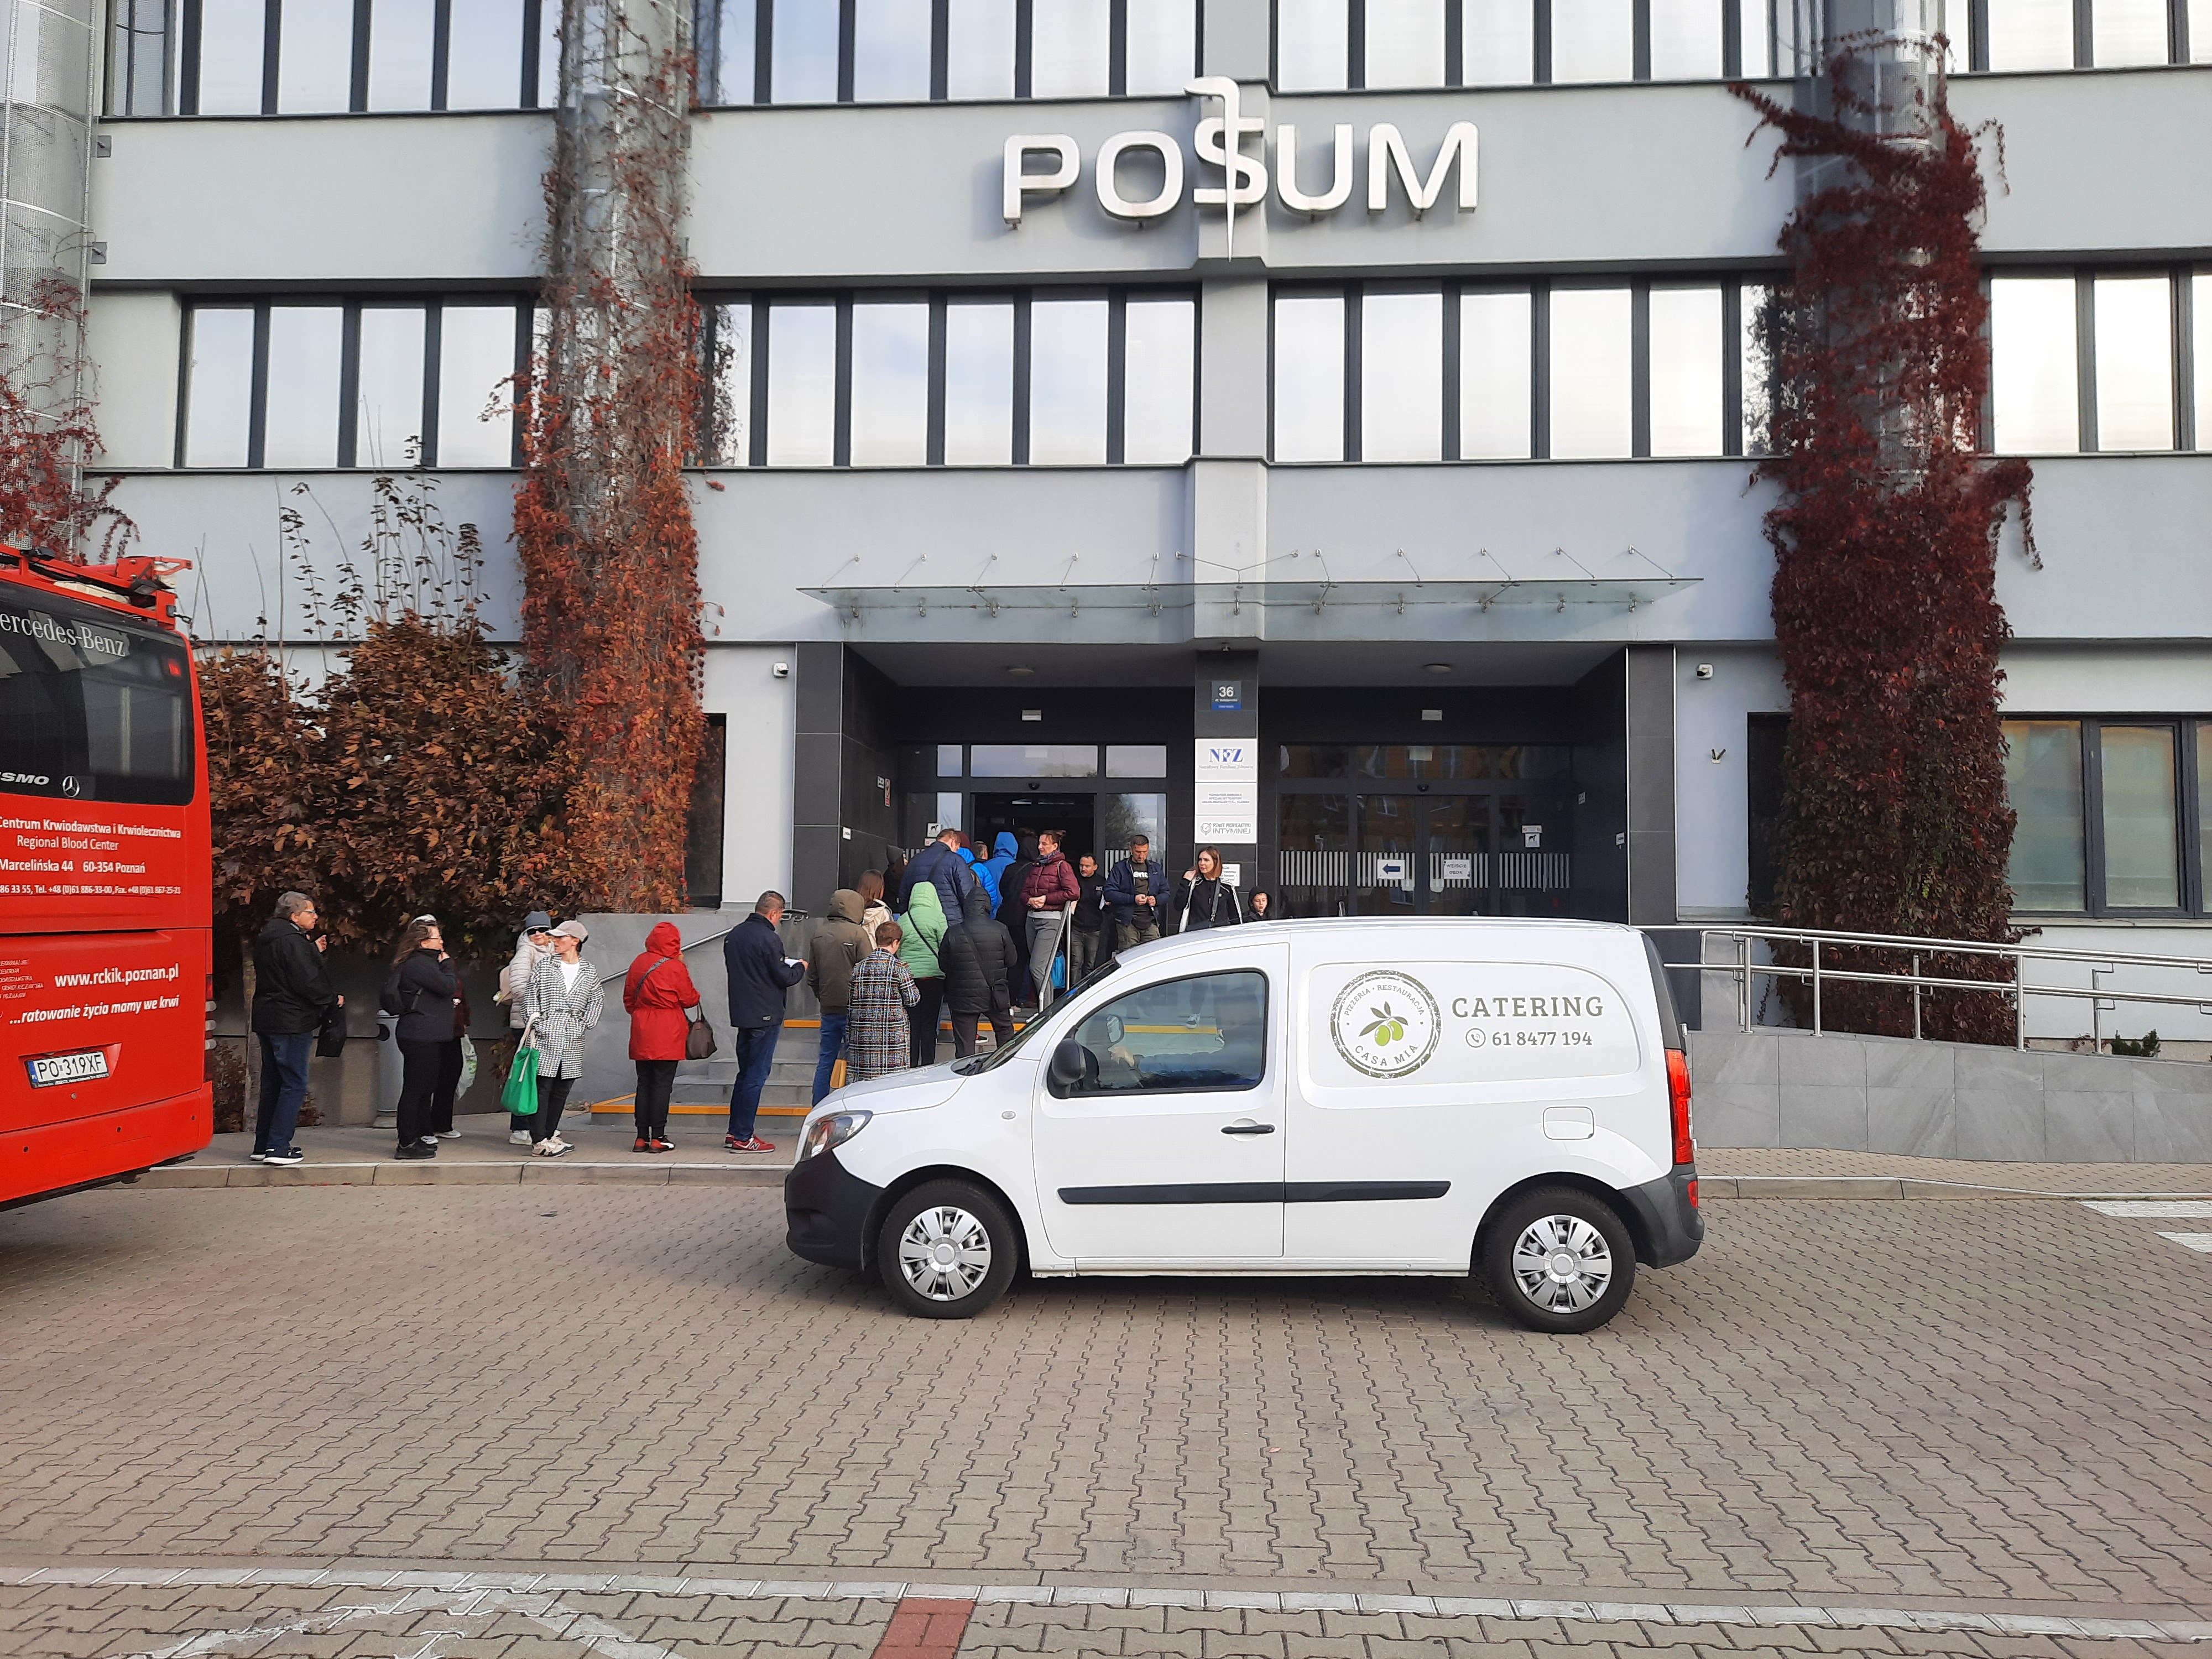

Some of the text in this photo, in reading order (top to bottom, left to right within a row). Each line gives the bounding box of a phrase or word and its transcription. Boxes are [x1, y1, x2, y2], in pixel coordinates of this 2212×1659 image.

[1003, 113, 1479, 225] POSUM
[0, 613, 126, 657] ercedes-Benz
[1219, 686, 1234, 697] 36
[1209, 748, 1244, 763] NFZ
[0, 772, 50, 785] SMO
[43, 818, 111, 834] Krwiodawstwa
[112, 823, 116, 834] i
[118, 823, 181, 838] Krwiolecznictwa
[17, 834, 120, 851] Regional Blood Center
[0, 858, 145, 873] Marcelińska 44 60-354 Poznań
[0, 885, 9, 894] 86
[11, 885, 20, 894] 33
[48, 885, 61, 894] +48
[62, 885, 80, 895] (0)61
[55, 963, 179, 987] www.rckik.poznan.pl
[82, 1001, 109, 1019] życia
[111, 1001, 142, 1014] mamy
[143, 999, 158, 1010] we
[159, 994, 180, 1009] krwi
[1344, 985, 1425, 1016] PIZZERIA RESTAURACJA
[1452, 996, 1604, 1017] CATERING
[1492, 1031, 1592, 1046] 61 8477 194
[62, 1054, 101, 1076] 319XF
[1355, 1045, 1418, 1066] CASA MIA
